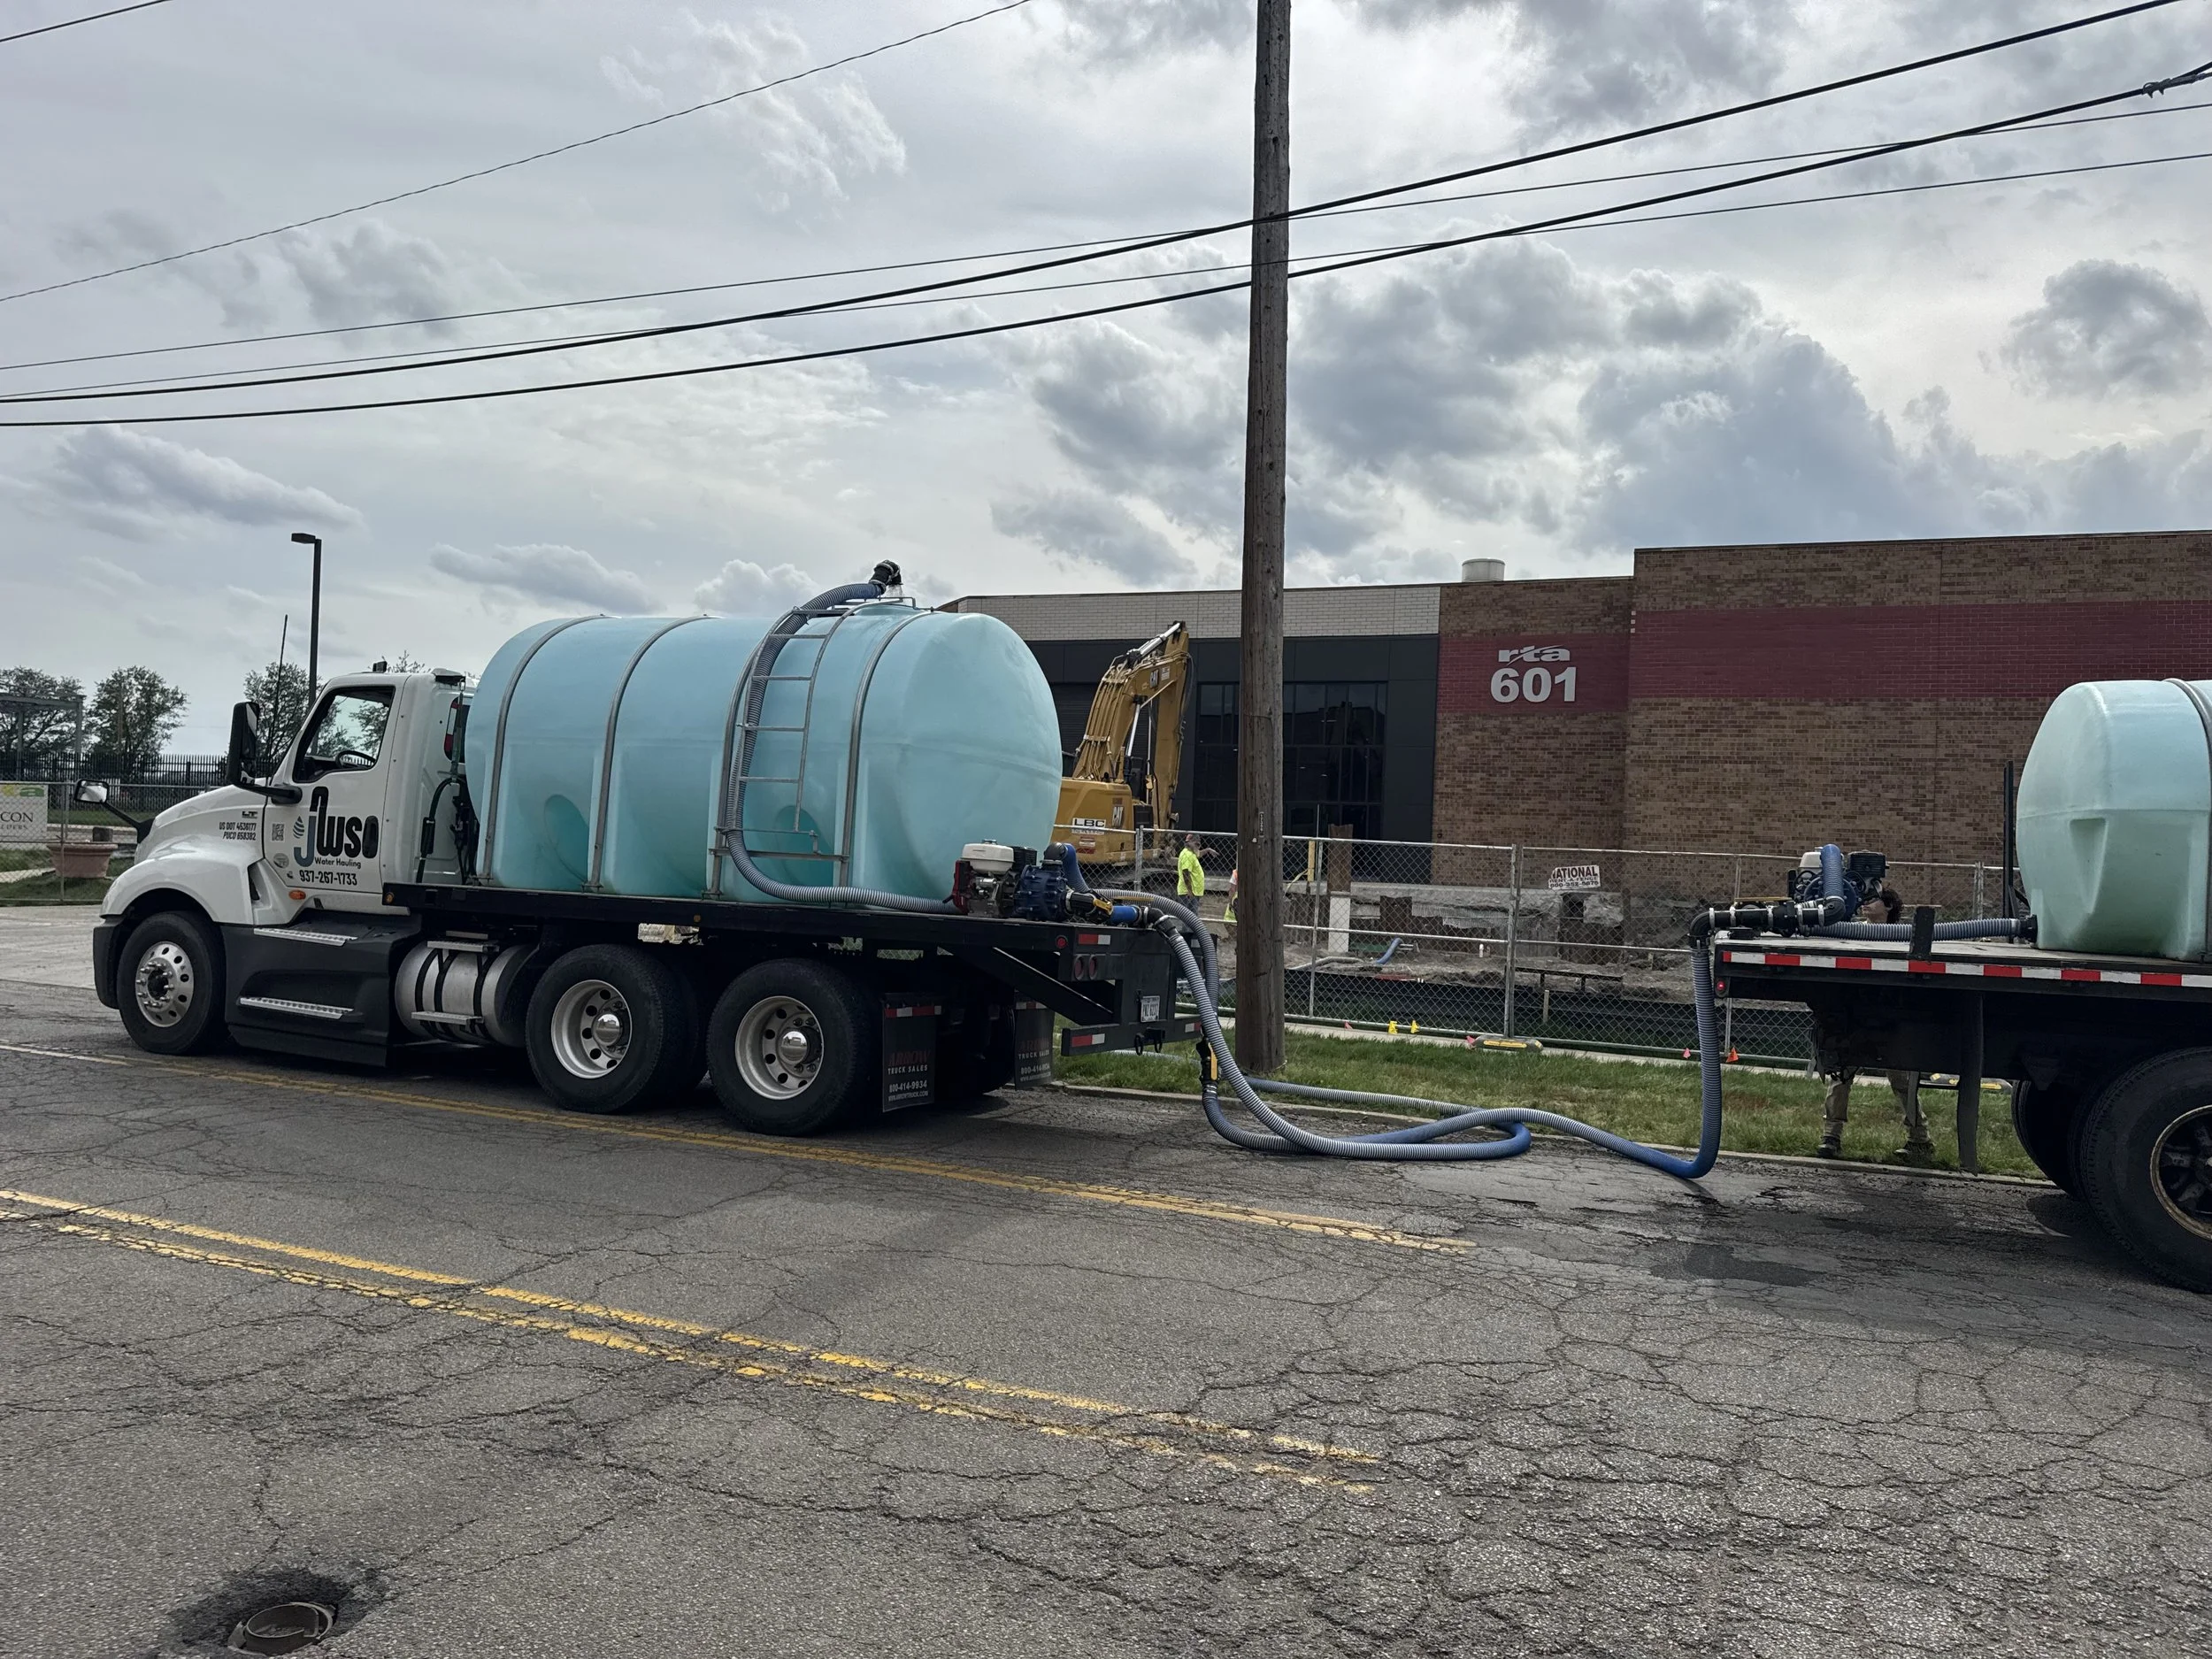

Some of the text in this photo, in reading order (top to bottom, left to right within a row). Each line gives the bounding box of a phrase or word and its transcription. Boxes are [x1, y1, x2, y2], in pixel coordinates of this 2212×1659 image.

[1498, 645, 1571, 664] rta
[1490, 666, 1577, 703] 601
[0, 811, 34, 823] CON
[1074, 818, 1105, 827] LBC
[227, 822, 236, 831] DOT
[314, 856, 362, 870] Water Hauling
[299, 869, 357, 886] 937-267-1733
[1018, 1051, 1038, 1060] TRUCK
[887, 1065, 906, 1075] TRUCK
[888, 1079, 928, 1094] 800-414-9934
